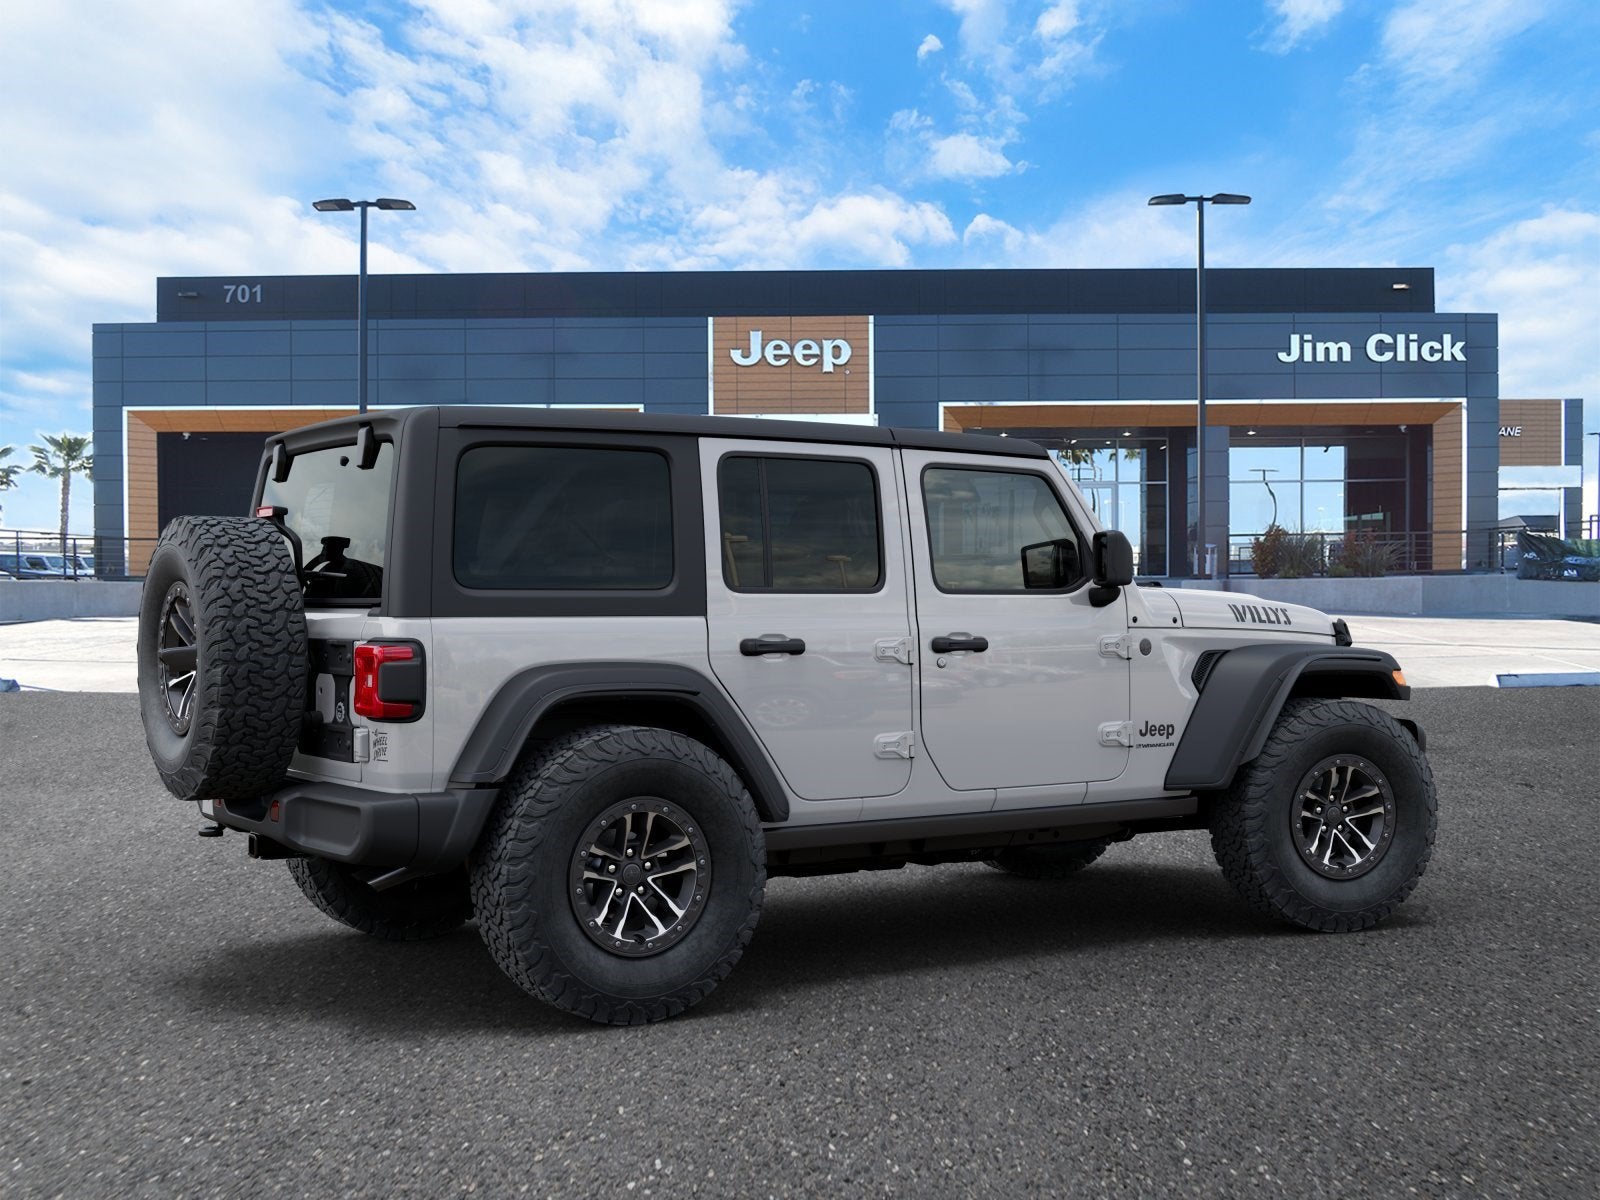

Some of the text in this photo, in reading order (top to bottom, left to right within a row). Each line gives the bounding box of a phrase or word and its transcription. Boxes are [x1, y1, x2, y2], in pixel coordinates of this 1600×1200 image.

[223, 284, 262, 304] 701
[729, 330, 852, 374] Jeep
[1277, 333, 1467, 363] Jim Click
[1227, 603, 1292, 625] WILLYS
[1139, 720, 1175, 740] Jeep
